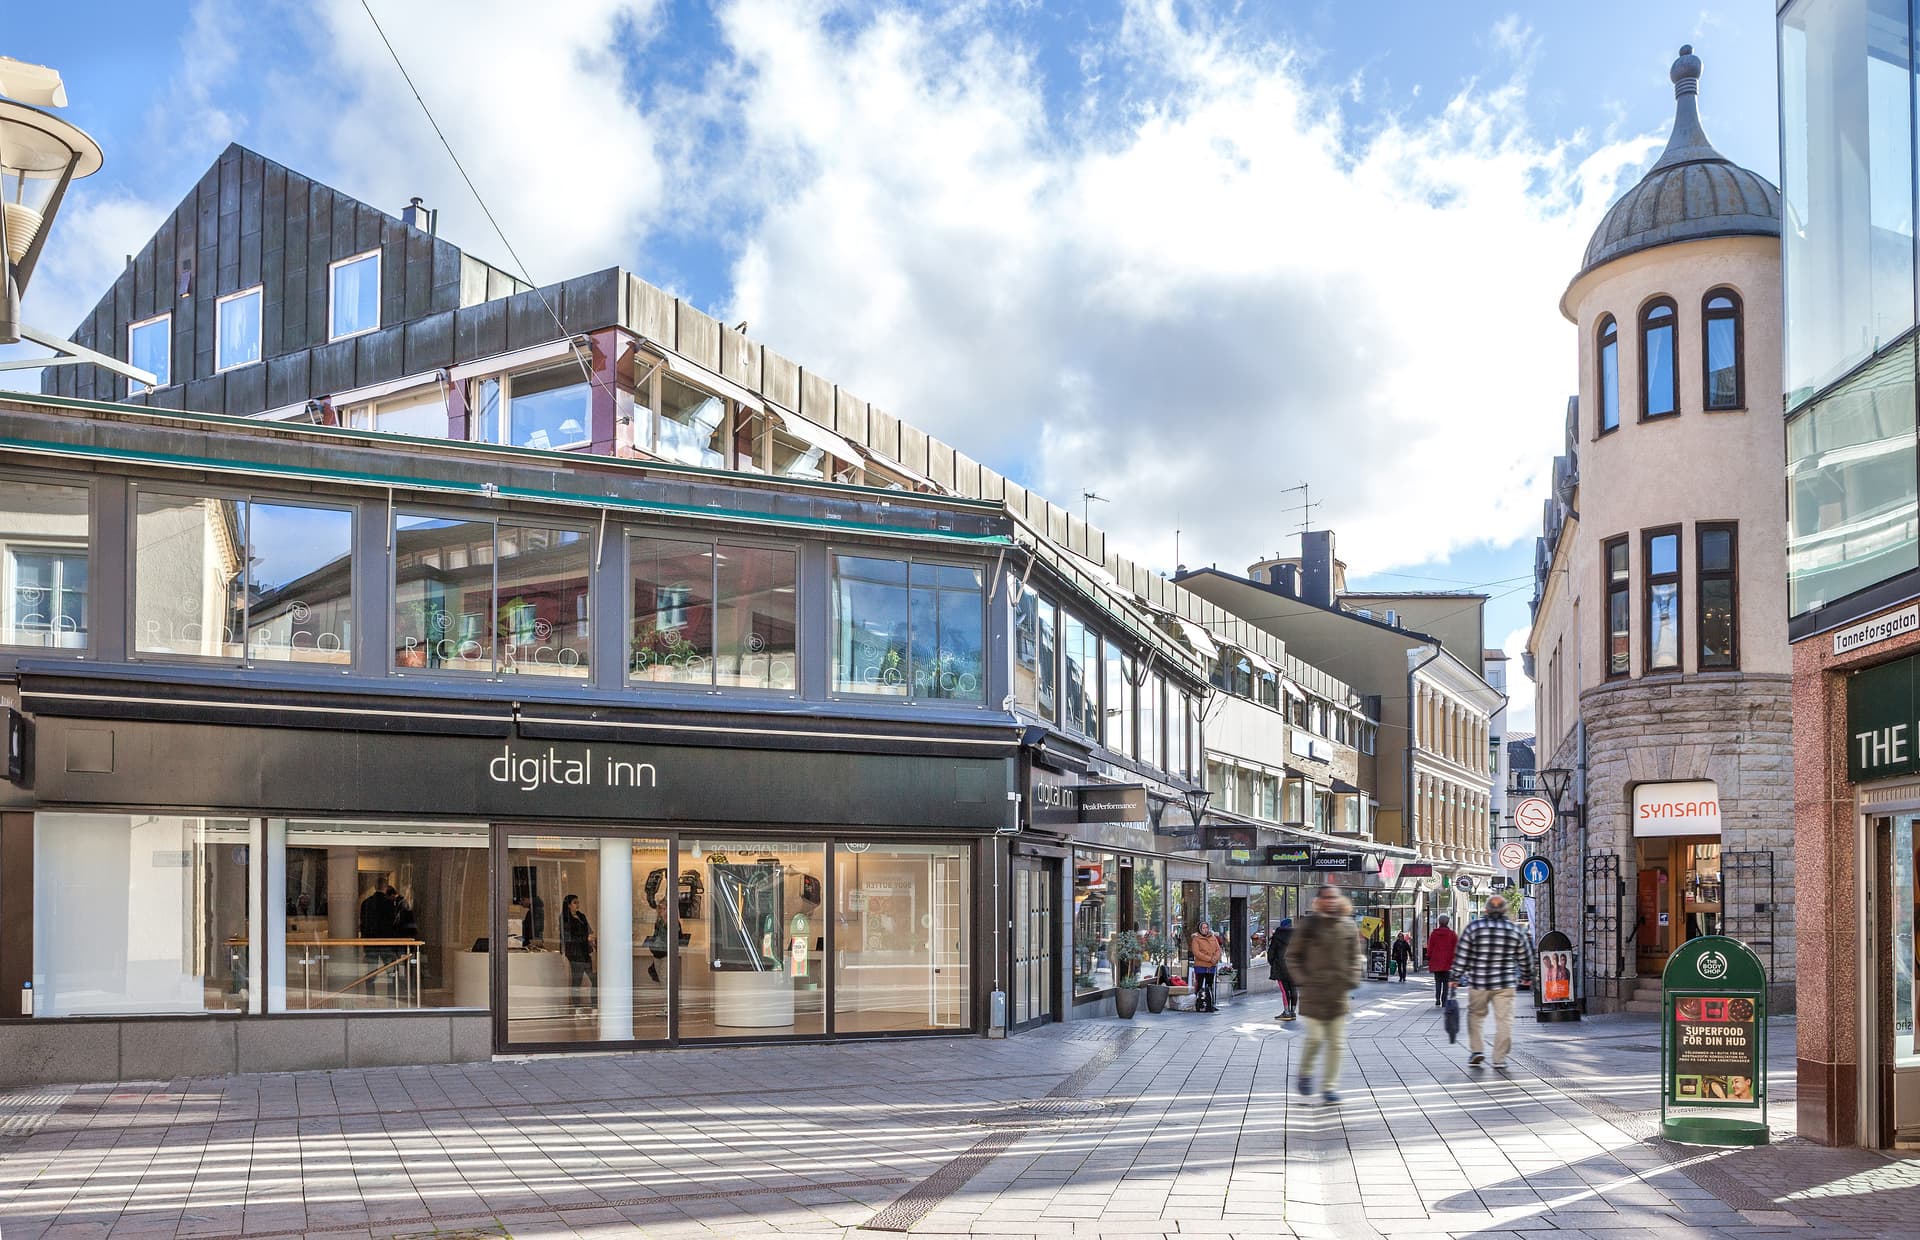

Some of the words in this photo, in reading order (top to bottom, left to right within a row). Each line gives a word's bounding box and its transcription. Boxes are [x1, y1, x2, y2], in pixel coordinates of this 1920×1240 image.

[258, 628, 341, 654] RICO
[1836, 613, 1916, 649] Tanneforsgatan
[405, 636, 483, 662] RICO
[504, 643, 579, 669] RICO
[635, 651, 706, 676] RICO
[915, 670, 977, 692] RICO
[1855, 723, 1908, 769] THE
[489, 744, 591, 791] digital
[607, 756, 657, 788] inn
[1082, 802, 1137, 811] PeakPerformance
[1640, 801, 1717, 819] SYNSAM
[1683, 1035, 1702, 1045] FÖR
[1705, 1037, 1722, 1045] DIN
[1726, 1037, 1746, 1046] HUD
[1685, 1026, 1744, 1036] SUPERFOOD
